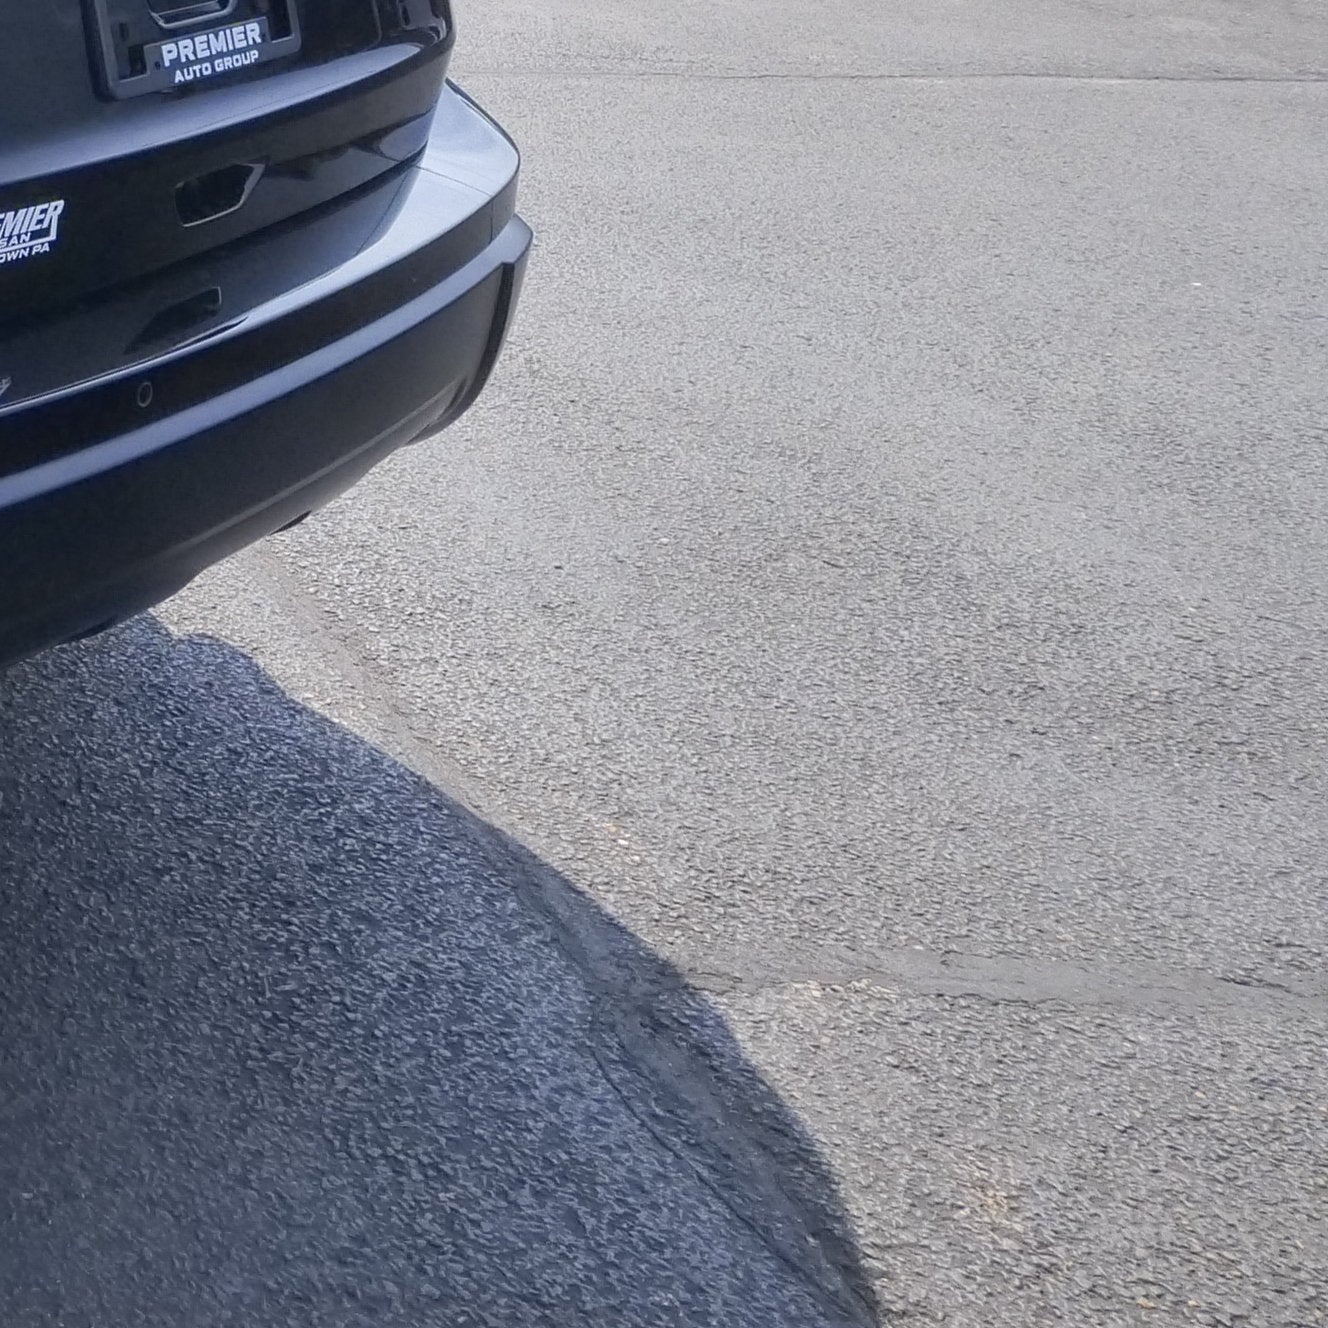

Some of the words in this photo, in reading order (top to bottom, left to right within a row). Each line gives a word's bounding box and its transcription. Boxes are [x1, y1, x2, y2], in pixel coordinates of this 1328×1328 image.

[161, 22, 262, 67] PREMIER
[174, 61, 212, 83] AUTO
[214, 50, 259, 72] GROUP
[31, 243, 50, 257] PA
